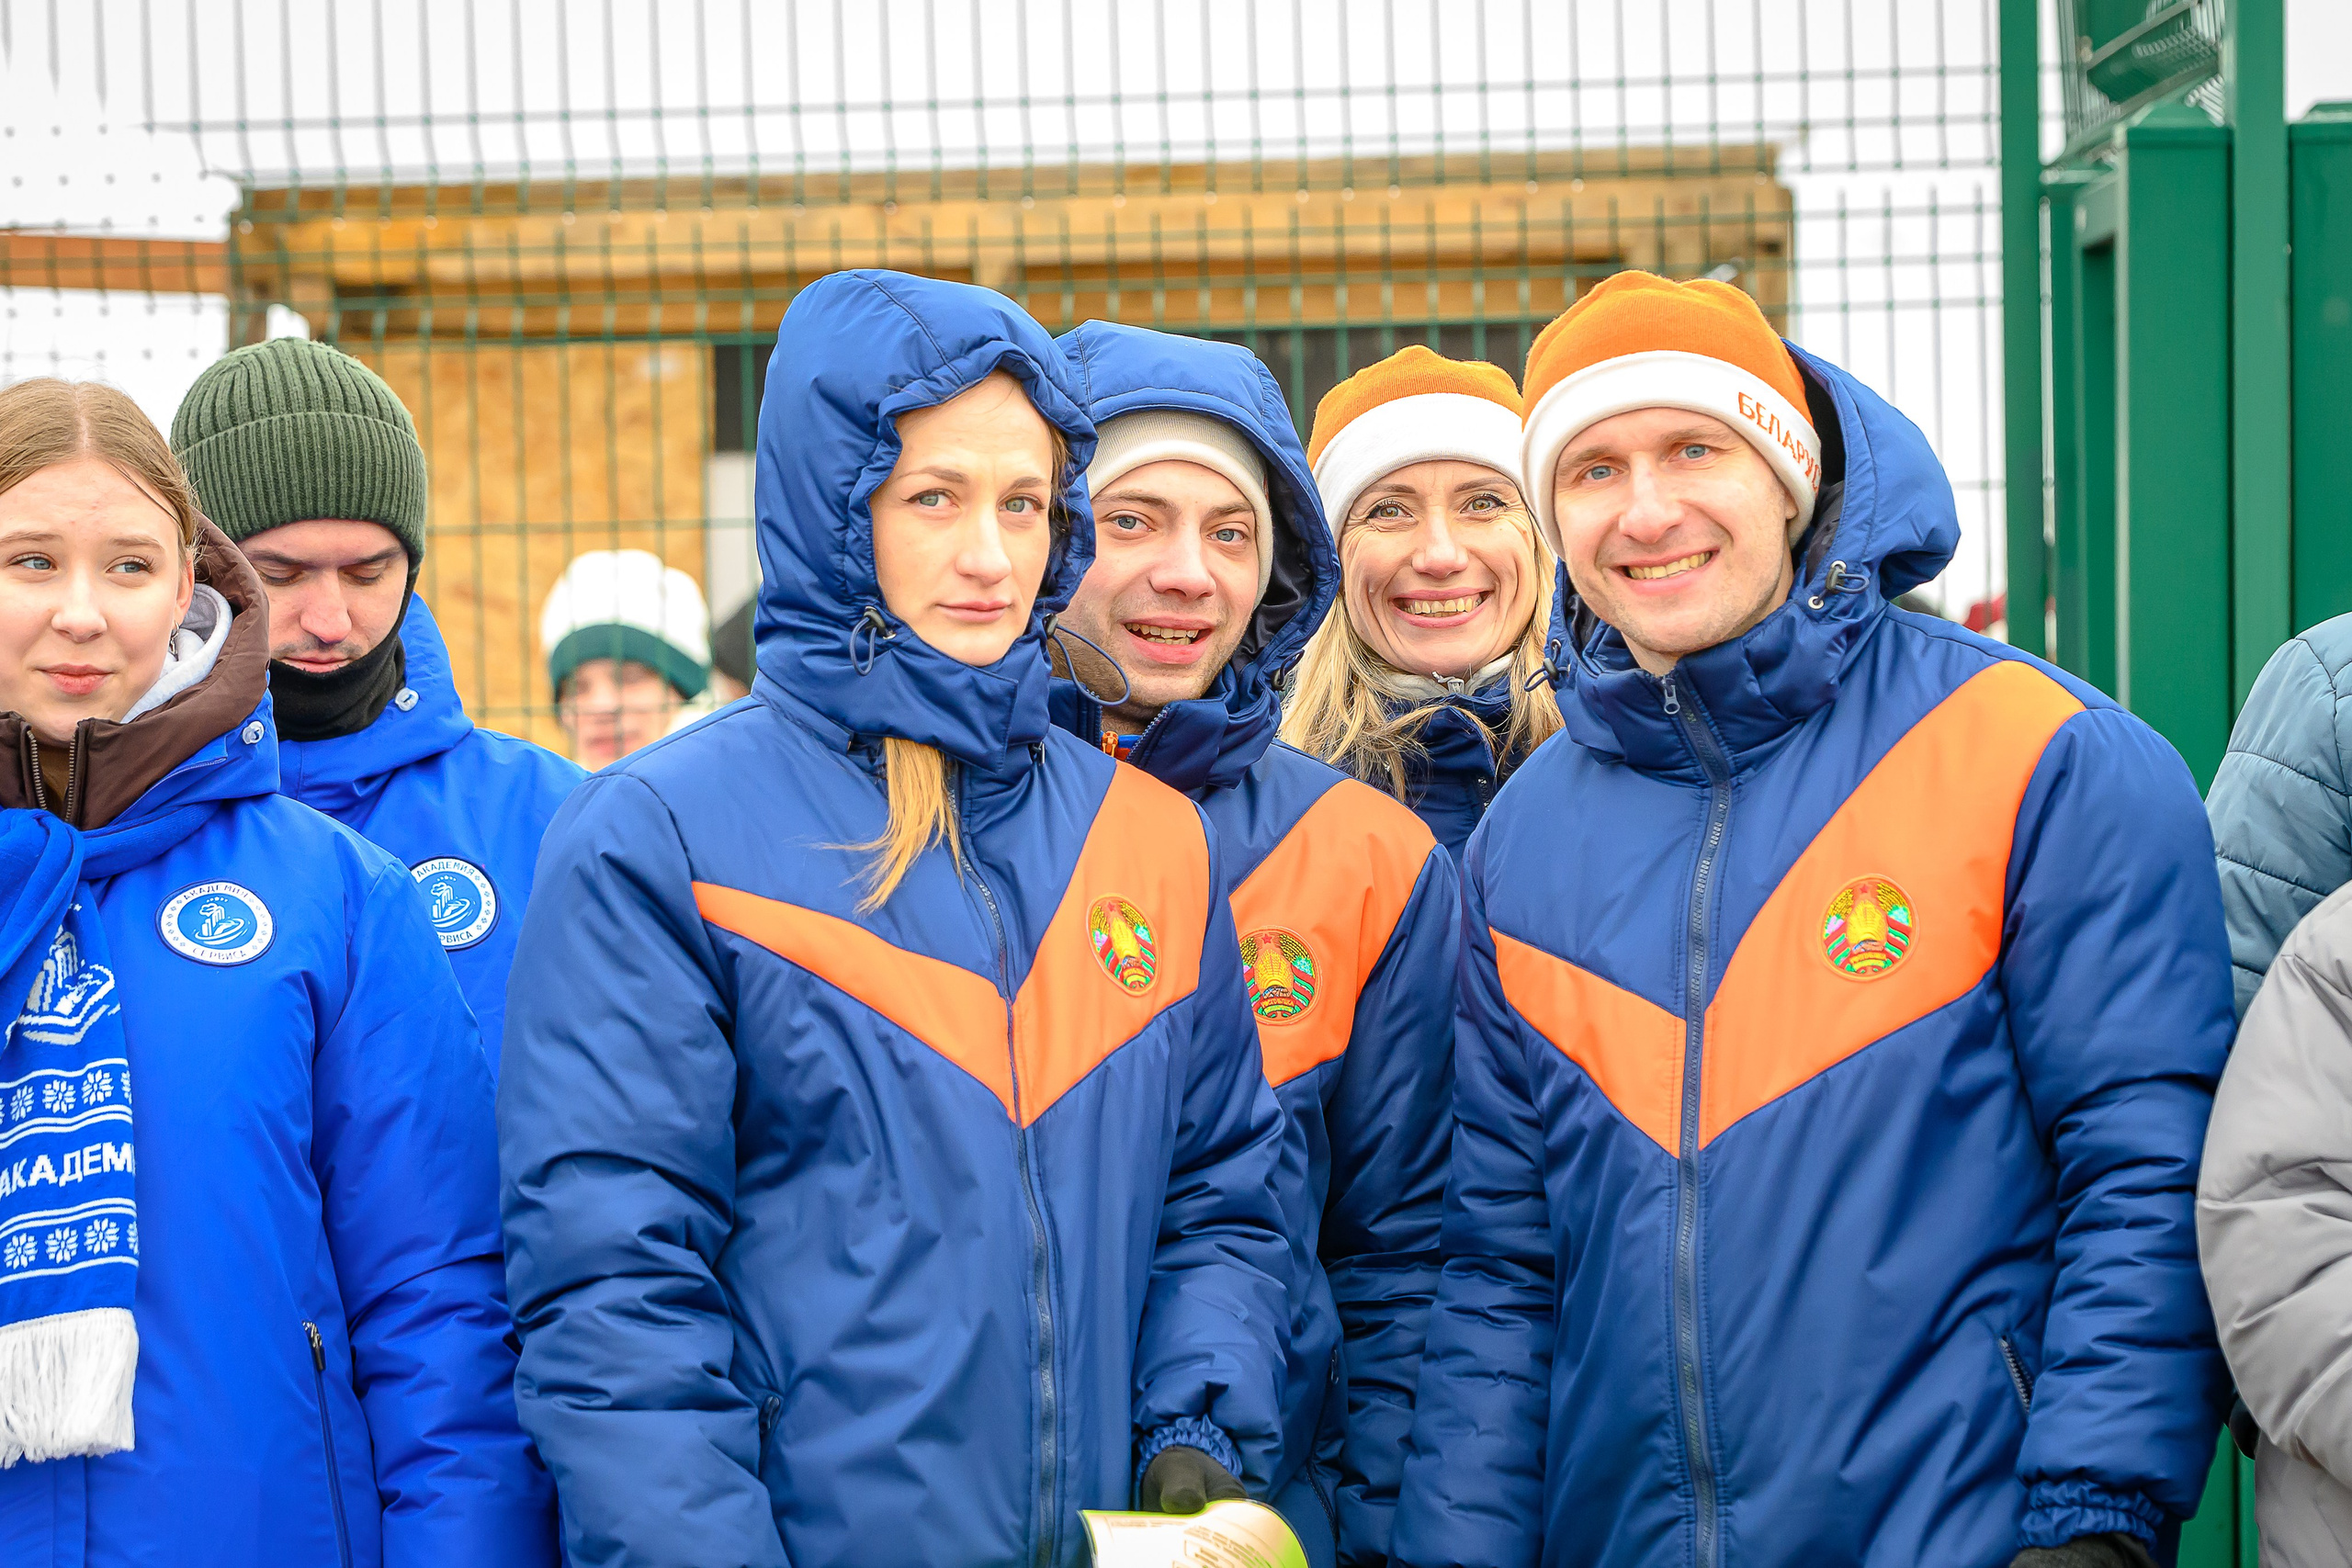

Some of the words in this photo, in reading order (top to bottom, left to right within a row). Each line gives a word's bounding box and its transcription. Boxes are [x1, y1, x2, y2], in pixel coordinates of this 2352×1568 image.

[416, 862, 475, 877] АКАДЕМИЯ
[439, 931, 473, 943] РВИСА
[0, 1141, 136, 1201] АКАДЕМ
